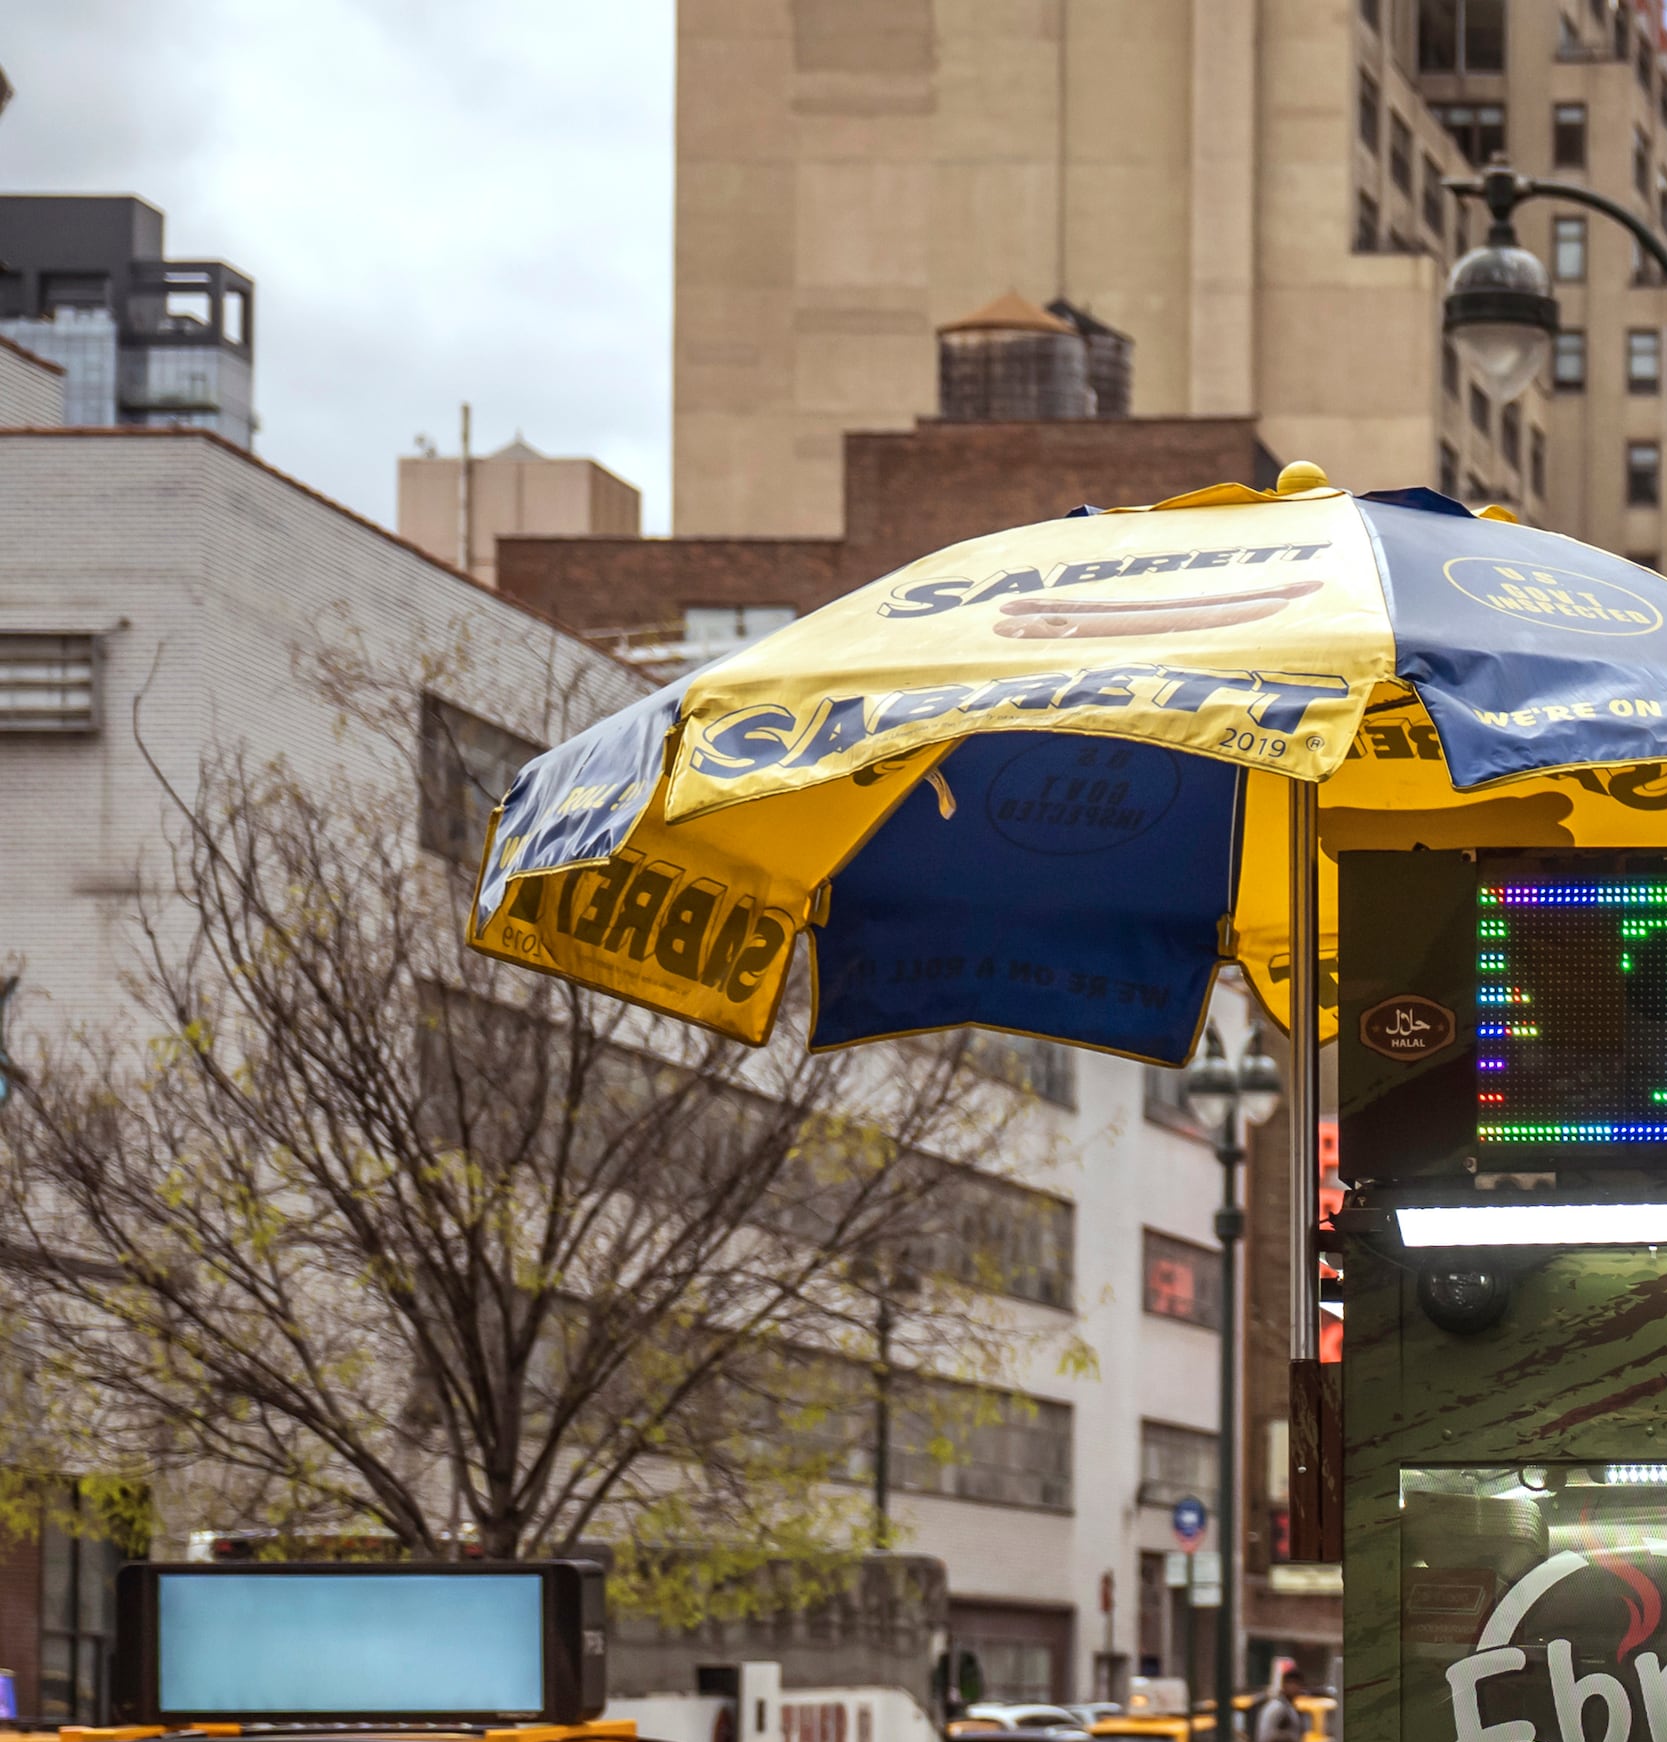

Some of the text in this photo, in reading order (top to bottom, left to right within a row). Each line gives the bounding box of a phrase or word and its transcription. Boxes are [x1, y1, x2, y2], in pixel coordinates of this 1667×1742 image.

[877, 540, 1332, 618] SABRETT
[1486, 593, 1652, 625] INSPECTED
[690, 662, 1350, 779] SABRETT
[1476, 702, 1595, 730] WE'RE
[1609, 698, 1665, 719] ON
[1218, 727, 1287, 759] 2019
[1385, 1008, 1431, 1036] حلال
[1391, 1039, 1426, 1048] HALAL
